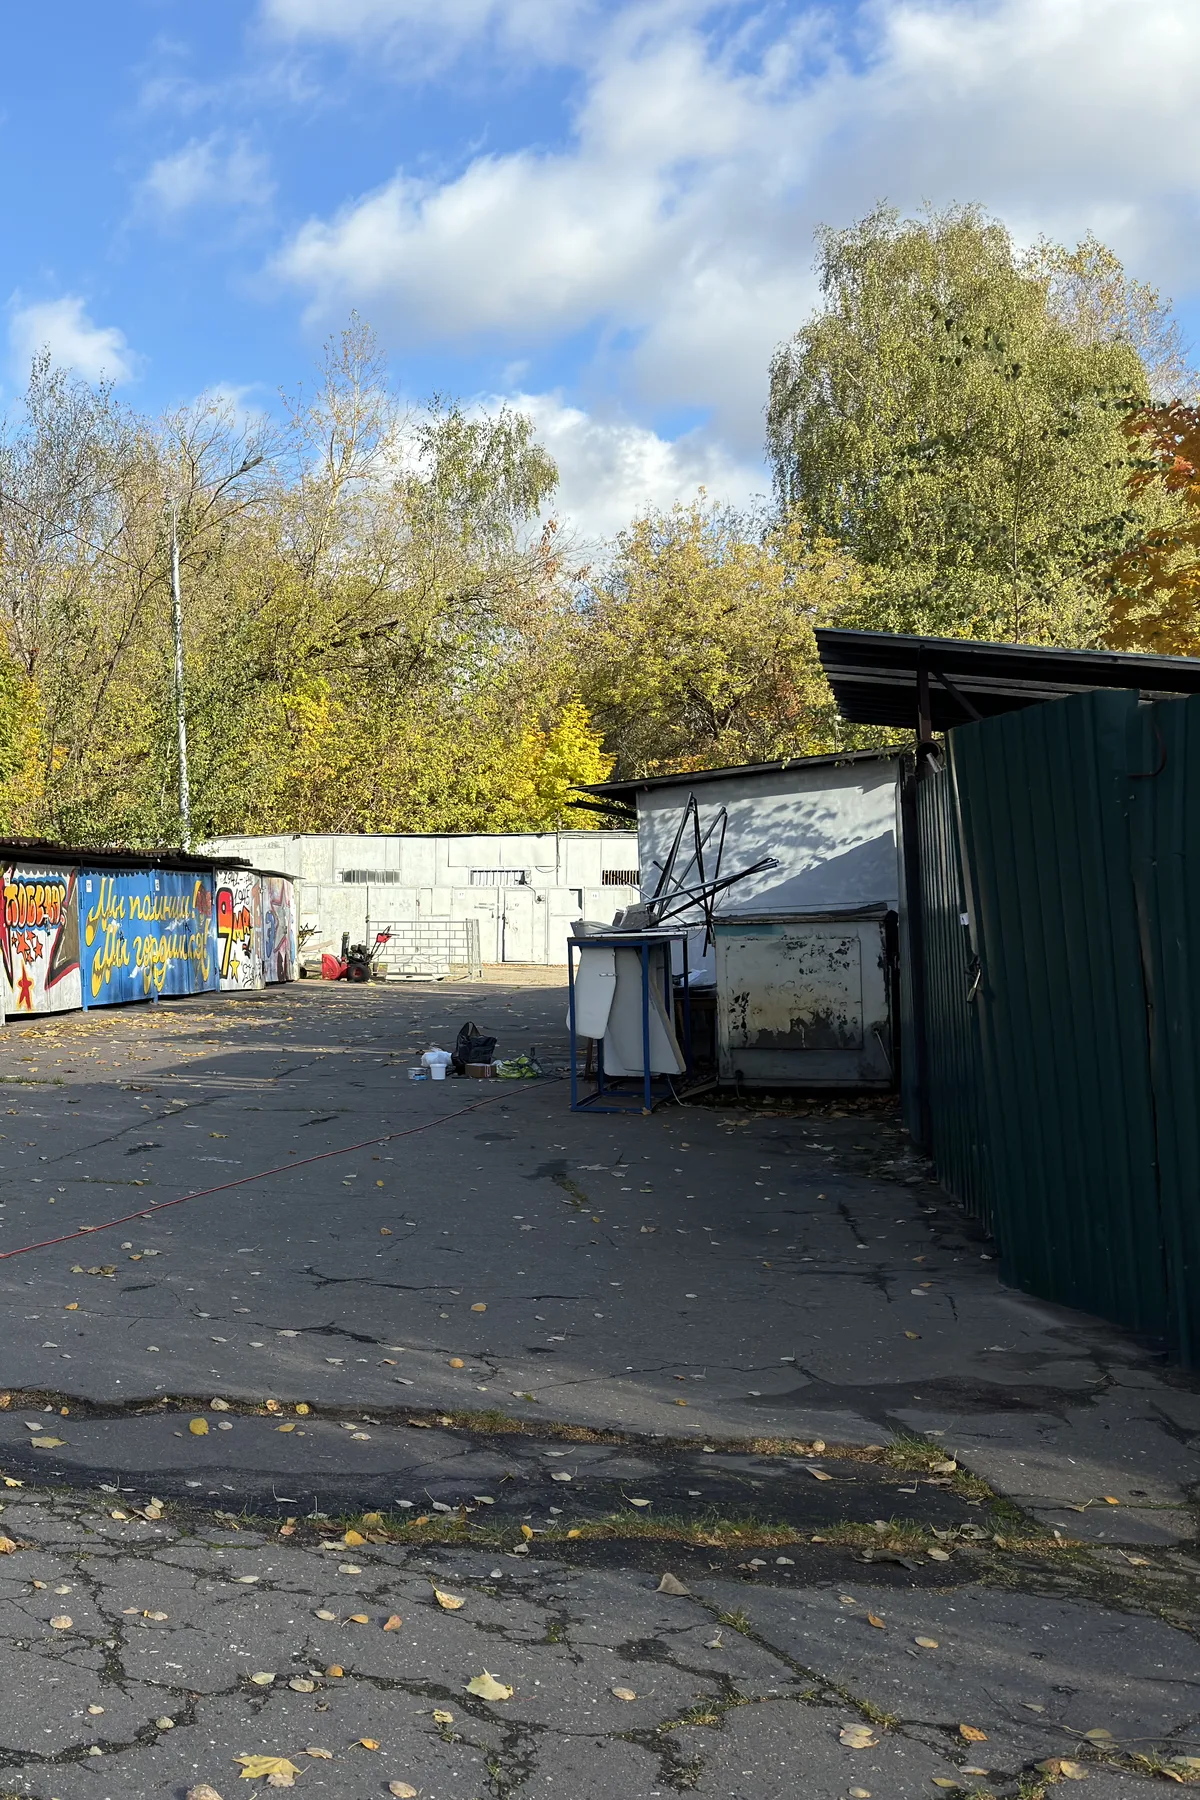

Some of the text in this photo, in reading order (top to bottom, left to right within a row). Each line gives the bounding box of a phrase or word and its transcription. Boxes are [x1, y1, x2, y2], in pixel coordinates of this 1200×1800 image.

[85, 877, 202, 946] Мы помним!
[216, 887, 234, 979] 9
[91, 924, 130, 998] Мы
